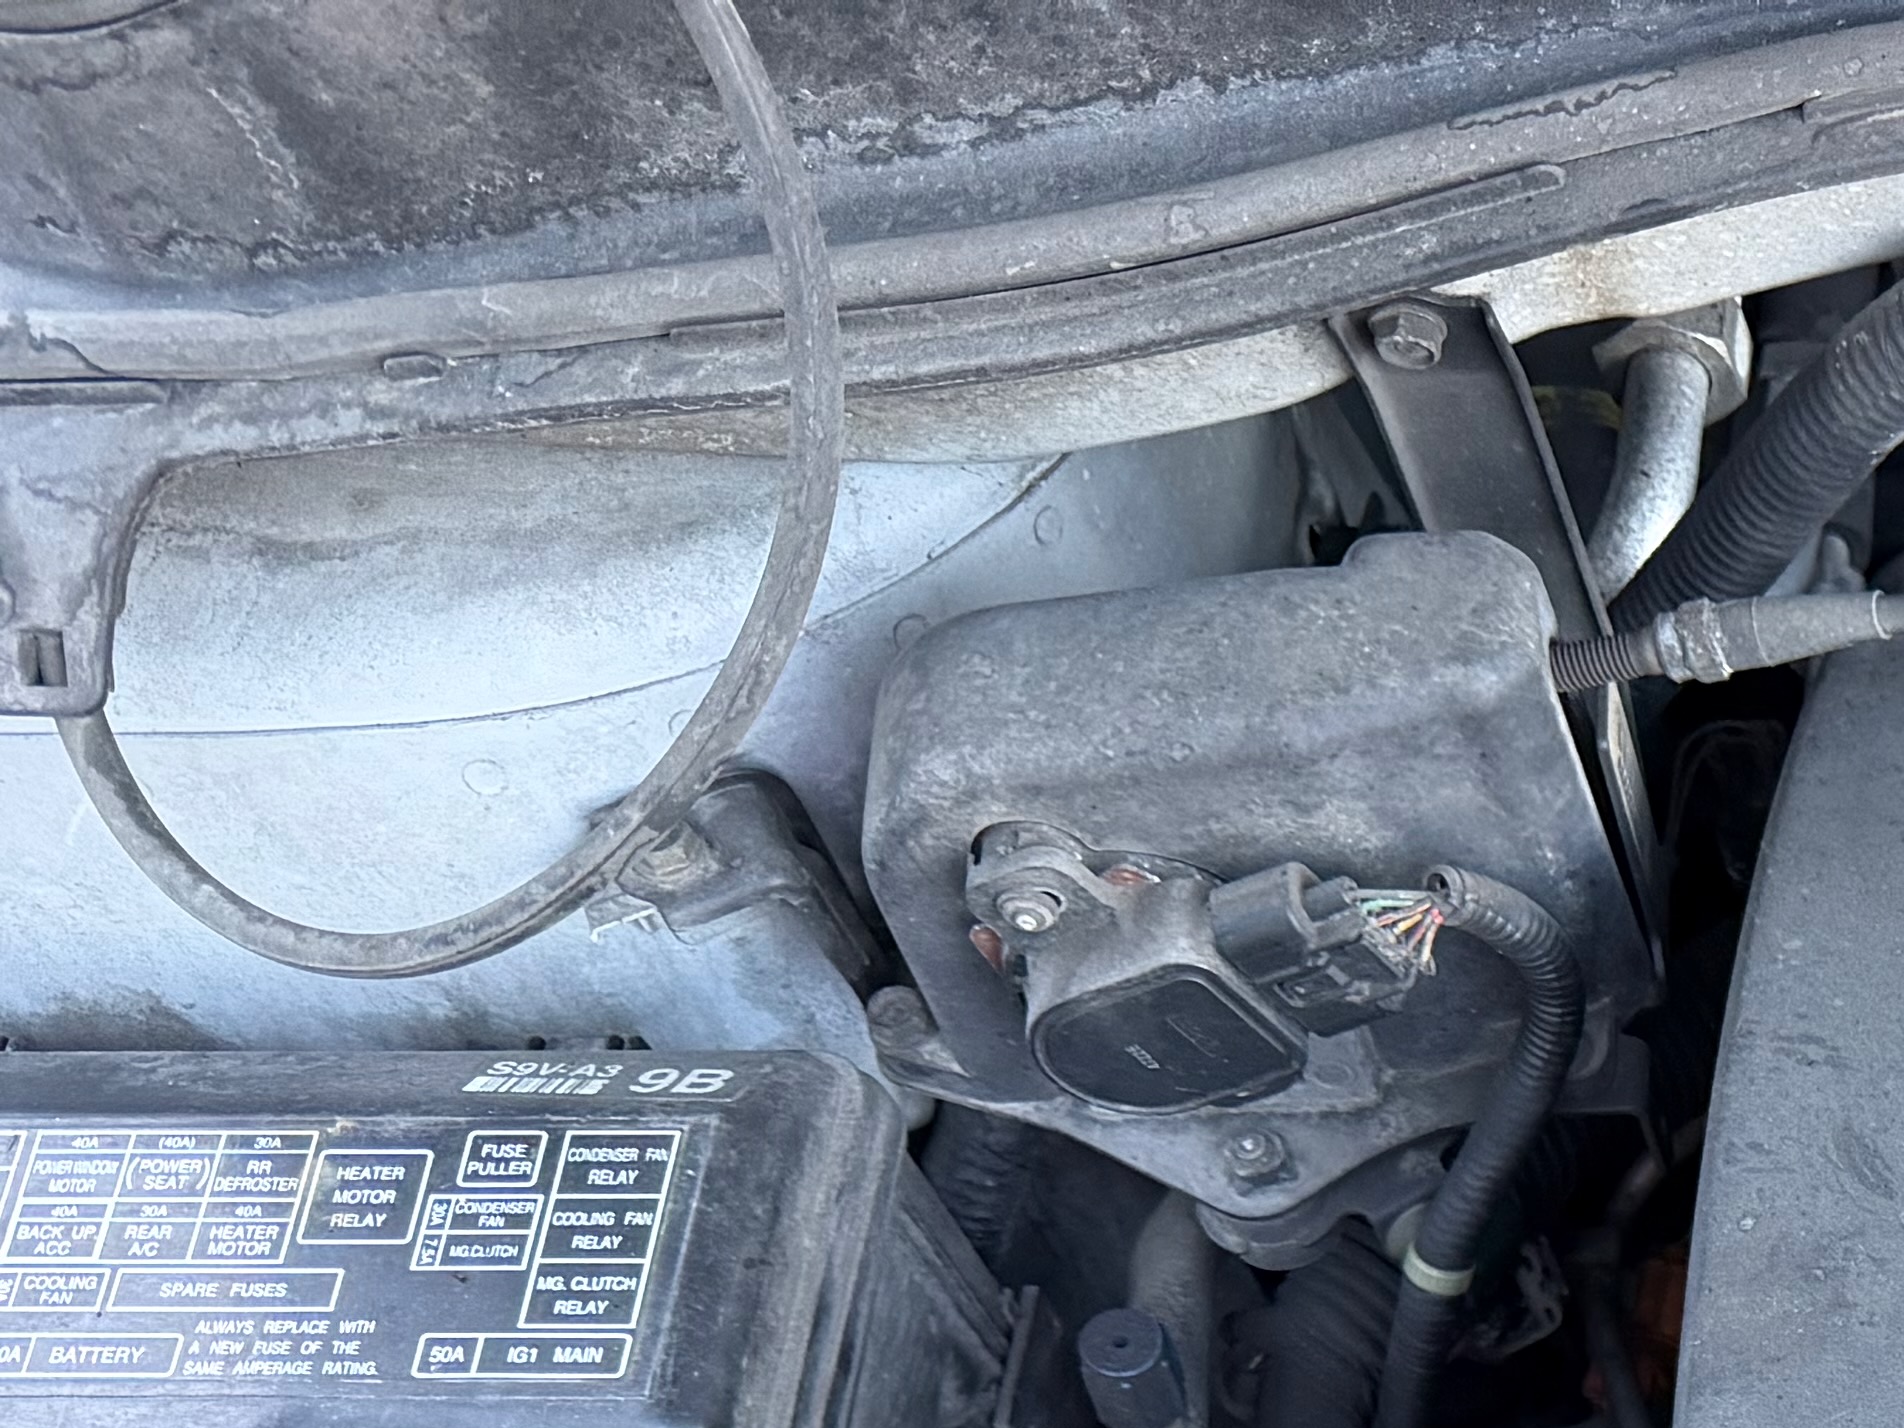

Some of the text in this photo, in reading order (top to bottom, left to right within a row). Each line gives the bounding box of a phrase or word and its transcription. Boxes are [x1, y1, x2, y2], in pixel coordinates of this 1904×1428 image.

[629, 1068, 734, 1093] 9B
[71, 1137, 99, 1149] 40A
[159, 1137, 195, 1149] (40A)
[254, 1137, 281, 1149] 30A
[481, 1144, 528, 1159] FUSE
[568, 1148, 669, 1162] CONDENSER FAN
[246, 1161, 272, 1175] RR
[337, 1165, 406, 1183] HEATER
[467, 1161, 533, 1176] PULLER
[214, 1177, 299, 1191] DEFROSTER
[587, 1170, 639, 1185] RELAY
[48, 1179, 96, 1193] MOTOR
[333, 1188, 397, 1206] MOTOR
[140, 1206, 168, 1218] 30A
[235, 1206, 262, 1218] 40A
[455, 1201, 535, 1215] CONDENSER
[330, 1211, 387, 1229] RELAY
[478, 1215, 504, 1227] FAN
[552, 1212, 653, 1226] COOLING FAN
[17, 1225, 64, 1240] BACK
[124, 1225, 172, 1240] REAR
[210, 1225, 279, 1240] HEATER
[34, 1241, 71, 1256] ACC
[128, 1241, 159, 1257] A/C
[208, 1241, 270, 1256] MOTOR
[571, 1236, 622, 1250] RELAY
[24, 1276, 98, 1291] COOLING
[159, 1283, 288, 1298] SPARE FUSES
[573, 1276, 636, 1291] CLUTCH
[39, 1291, 73, 1305] FAN
[553, 1301, 609, 1316] RELAY
[195, 1320, 375, 1334] ALWAYS REPLACE WITH
[49, 1346, 144, 1364] BATTERY
[188, 1340, 360, 1355] A NEW FUSE OF THE
[428, 1348, 465, 1363] 50A
[554, 1348, 603, 1363] MAIN
[183, 1361, 225, 1375] SAME
[233, 1361, 313, 1375] AMPERAGE
